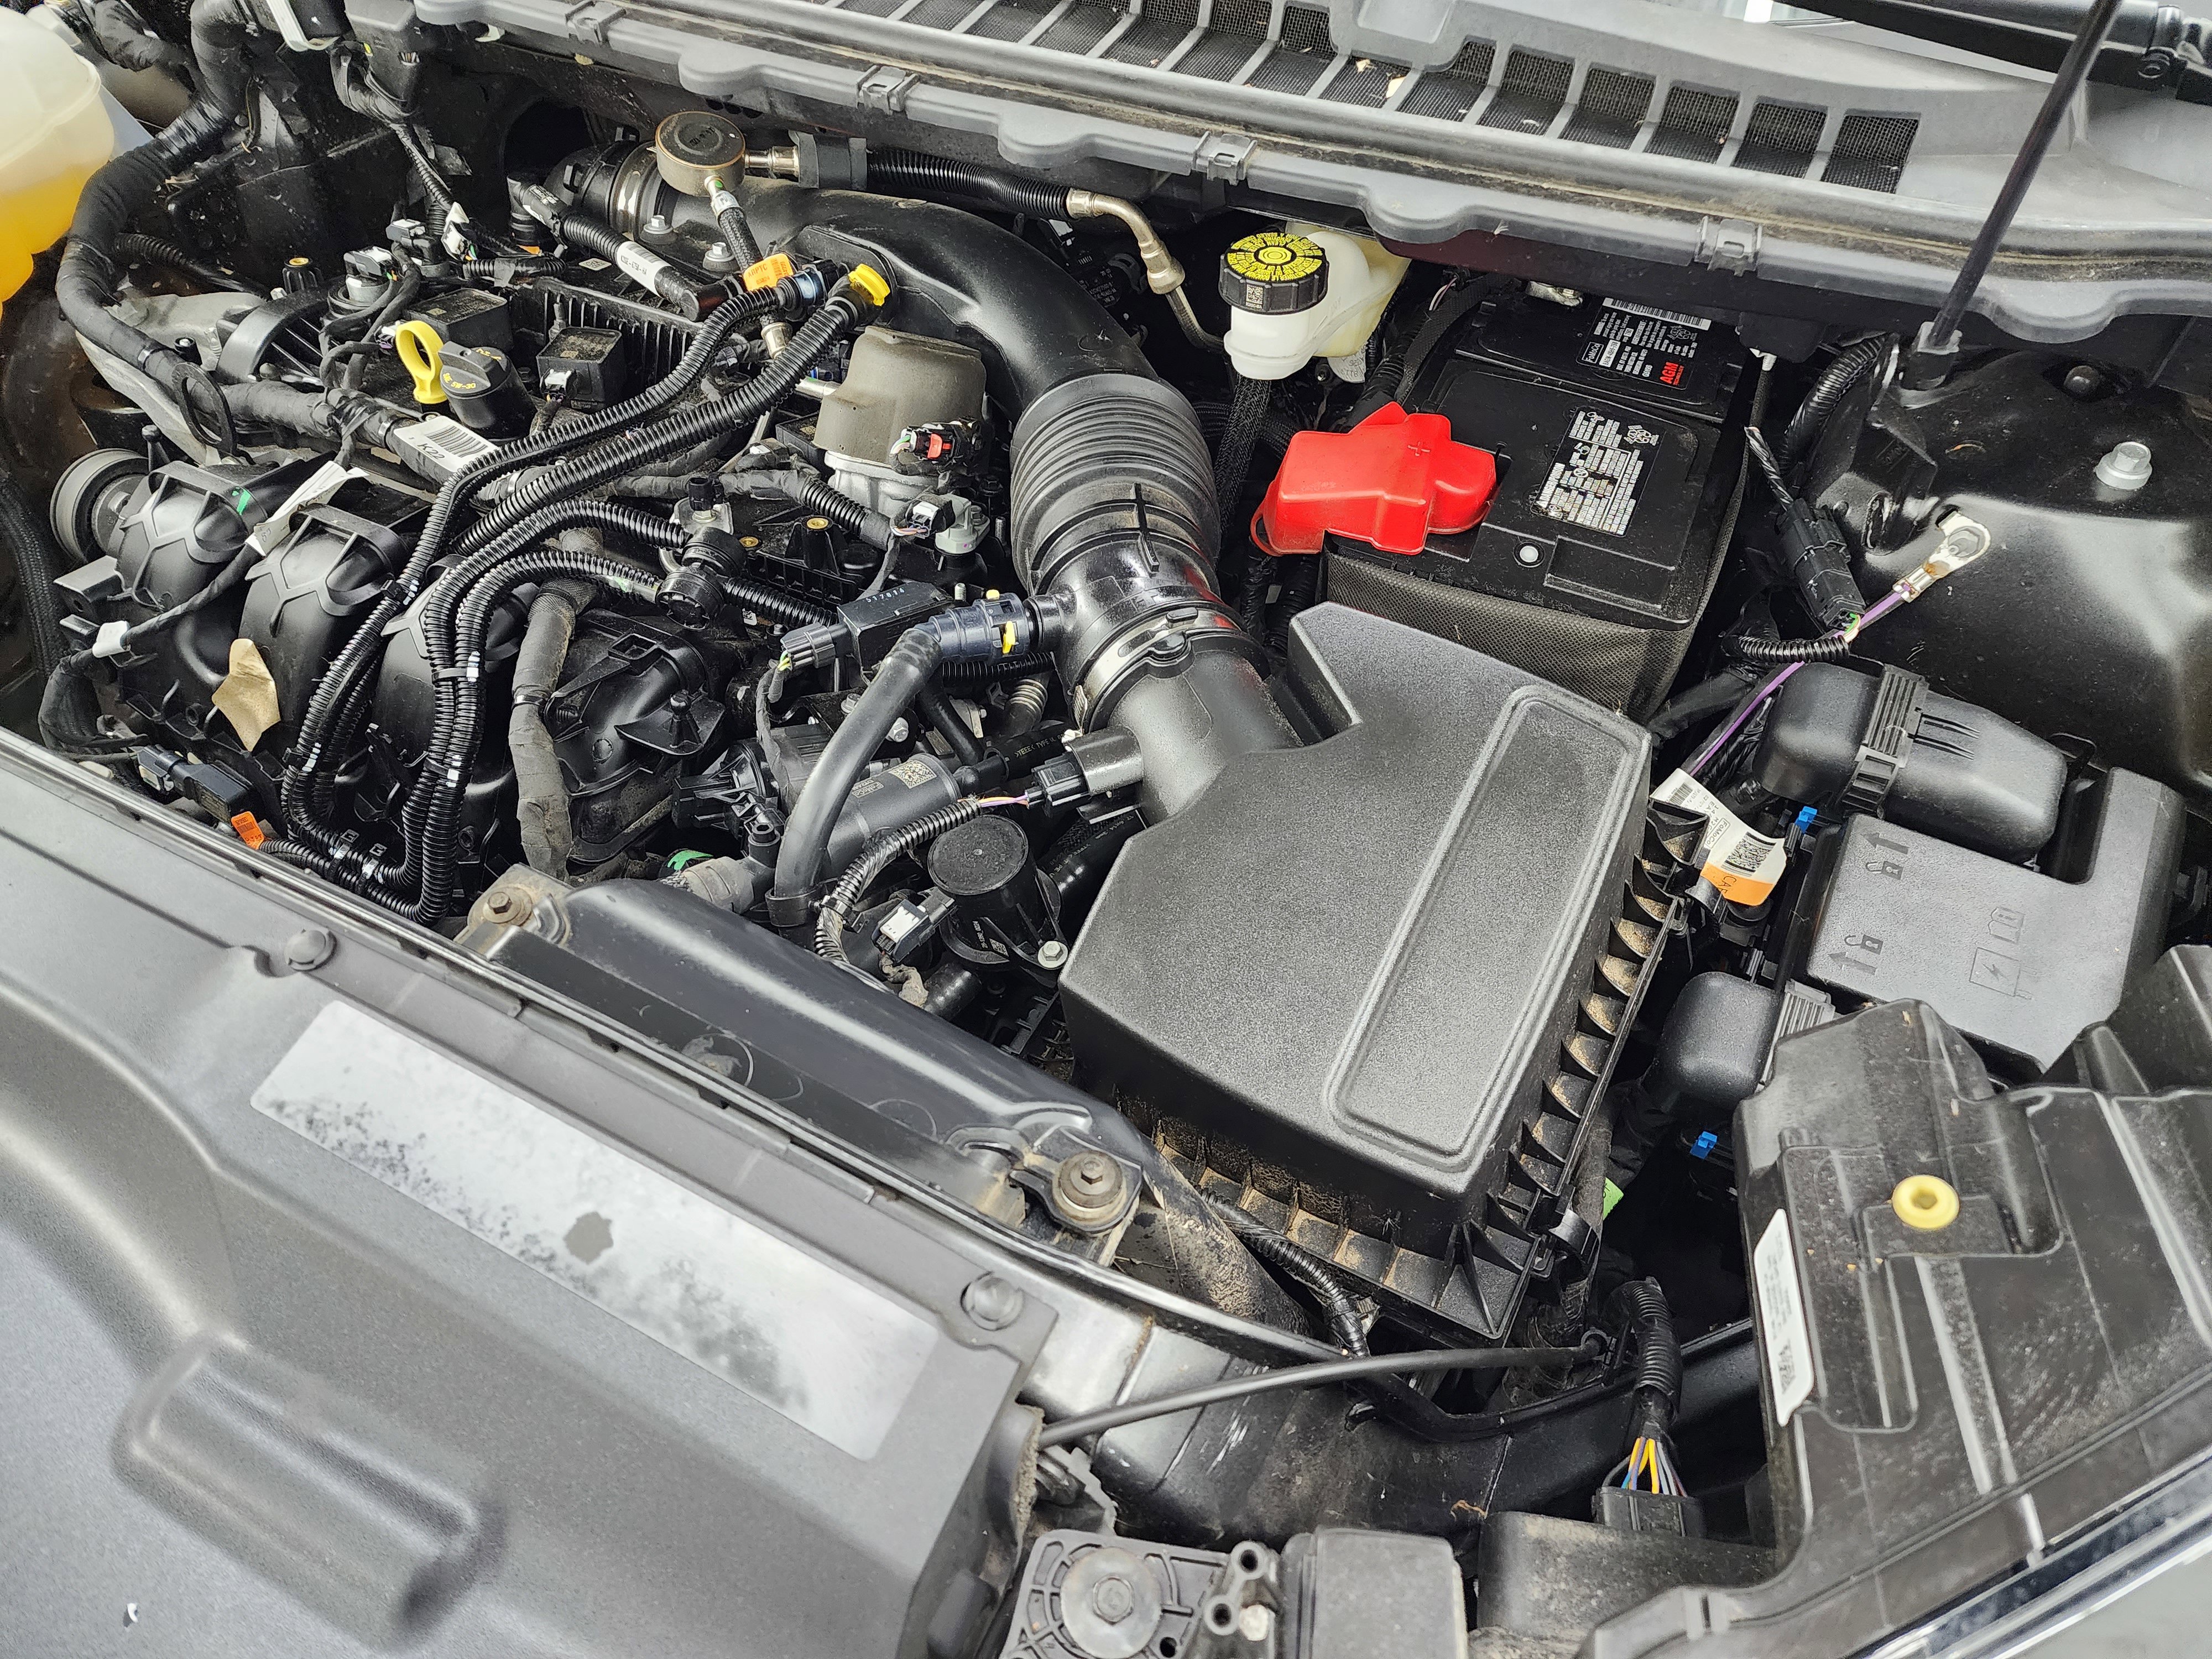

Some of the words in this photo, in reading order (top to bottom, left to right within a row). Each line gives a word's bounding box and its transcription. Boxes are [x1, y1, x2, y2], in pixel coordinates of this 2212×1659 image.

[1585, 342, 1600, 362] FoMoCo
[1659, 361, 1678, 384] AGM
[416, 440, 445, 461] K22
[854, 782, 881, 795] FoMoCo
[1705, 820, 1728, 846] FoMoCo
